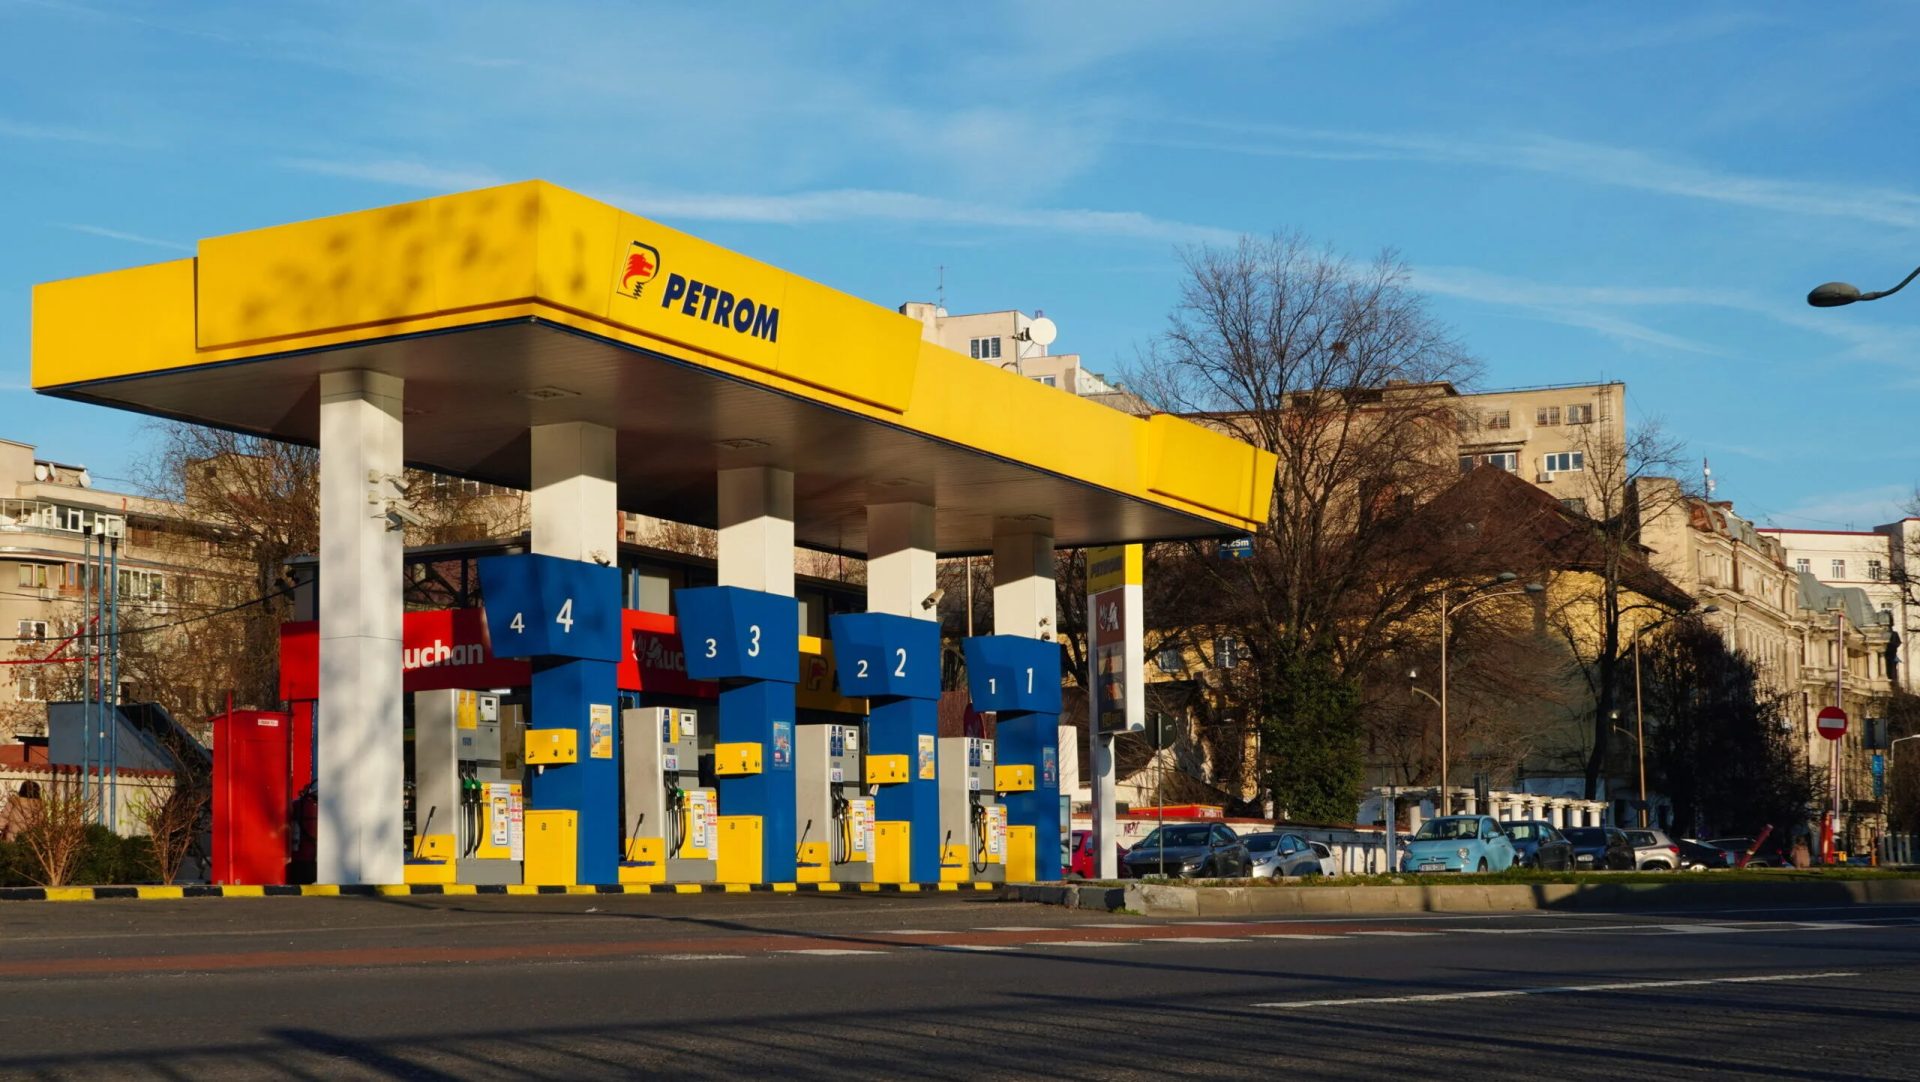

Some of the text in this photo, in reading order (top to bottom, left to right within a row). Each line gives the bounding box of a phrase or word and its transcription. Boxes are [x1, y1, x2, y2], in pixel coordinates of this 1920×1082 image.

[661, 273, 780, 343] PETROM
[510, 612, 525, 634] 4
[556, 598, 574, 633] 4
[402, 639, 484, 669] uchan
[705, 638, 717, 658] 3
[748, 625, 761, 657] 3
[857, 659, 868, 678] 2
[894, 648, 907, 677] 2
[988, 678, 996, 695] 1
[1026, 667, 1033, 694] 1
